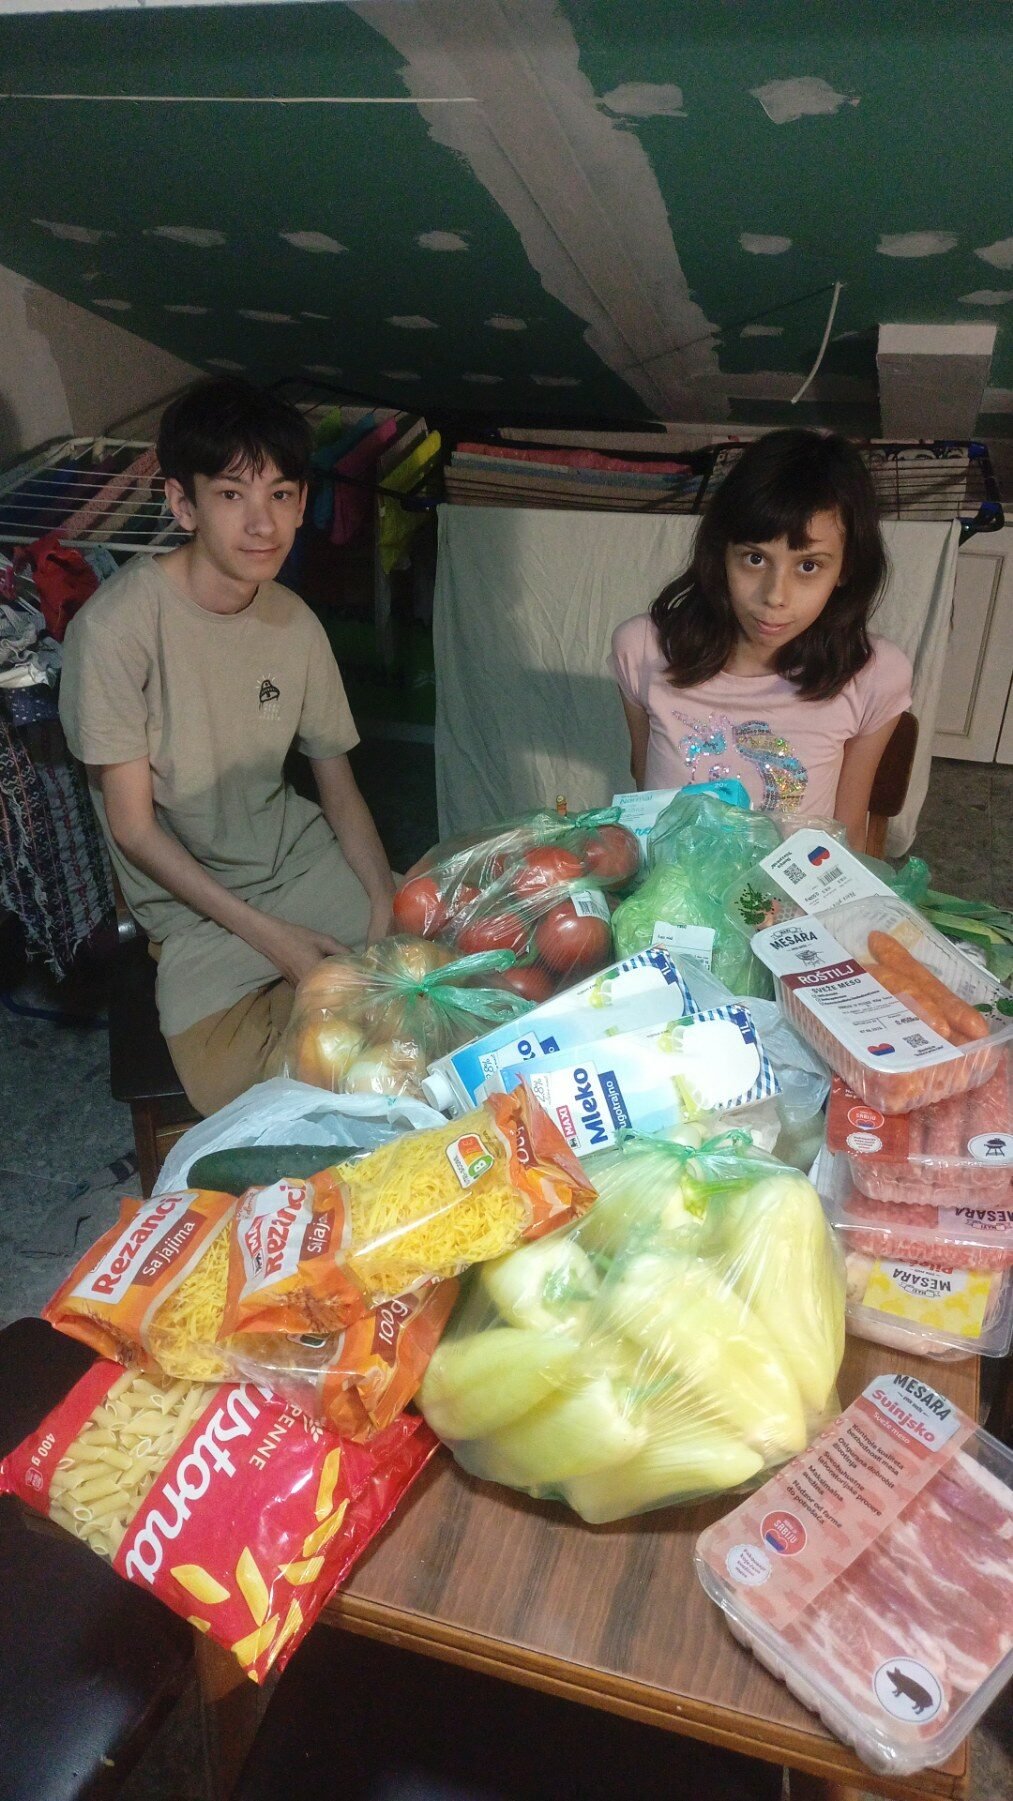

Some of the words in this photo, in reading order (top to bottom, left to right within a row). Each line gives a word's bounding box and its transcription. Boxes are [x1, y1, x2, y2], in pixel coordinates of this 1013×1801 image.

[769, 931, 818, 950] MESARA
[797, 964, 854, 984] ROŠTILJ
[838, 978, 861, 989] MESO
[558, 1107, 574, 1136] MAXI
[573, 1067, 608, 1145] Mleko
[606, 1080, 627, 1129] ugotrajno
[91, 1197, 182, 1296] Rezanci
[142, 1259, 163, 1276] Sa
[155, 1222, 195, 1263] jajima
[892, 1268, 951, 1292] MESARA
[893, 1374, 951, 1421] MESARA
[37, 1433, 56, 1457] 400
[248, 1403, 303, 1471] PENNE
[31, 1455, 41, 1467] g
[125, 1382, 274, 1585] ustona
[786, 1486, 796, 1496] do
[808, 1465, 844, 1502] Maksimalna
[792, 1479, 815, 1503] Nadzor
[822, 1508, 842, 1528] farme
